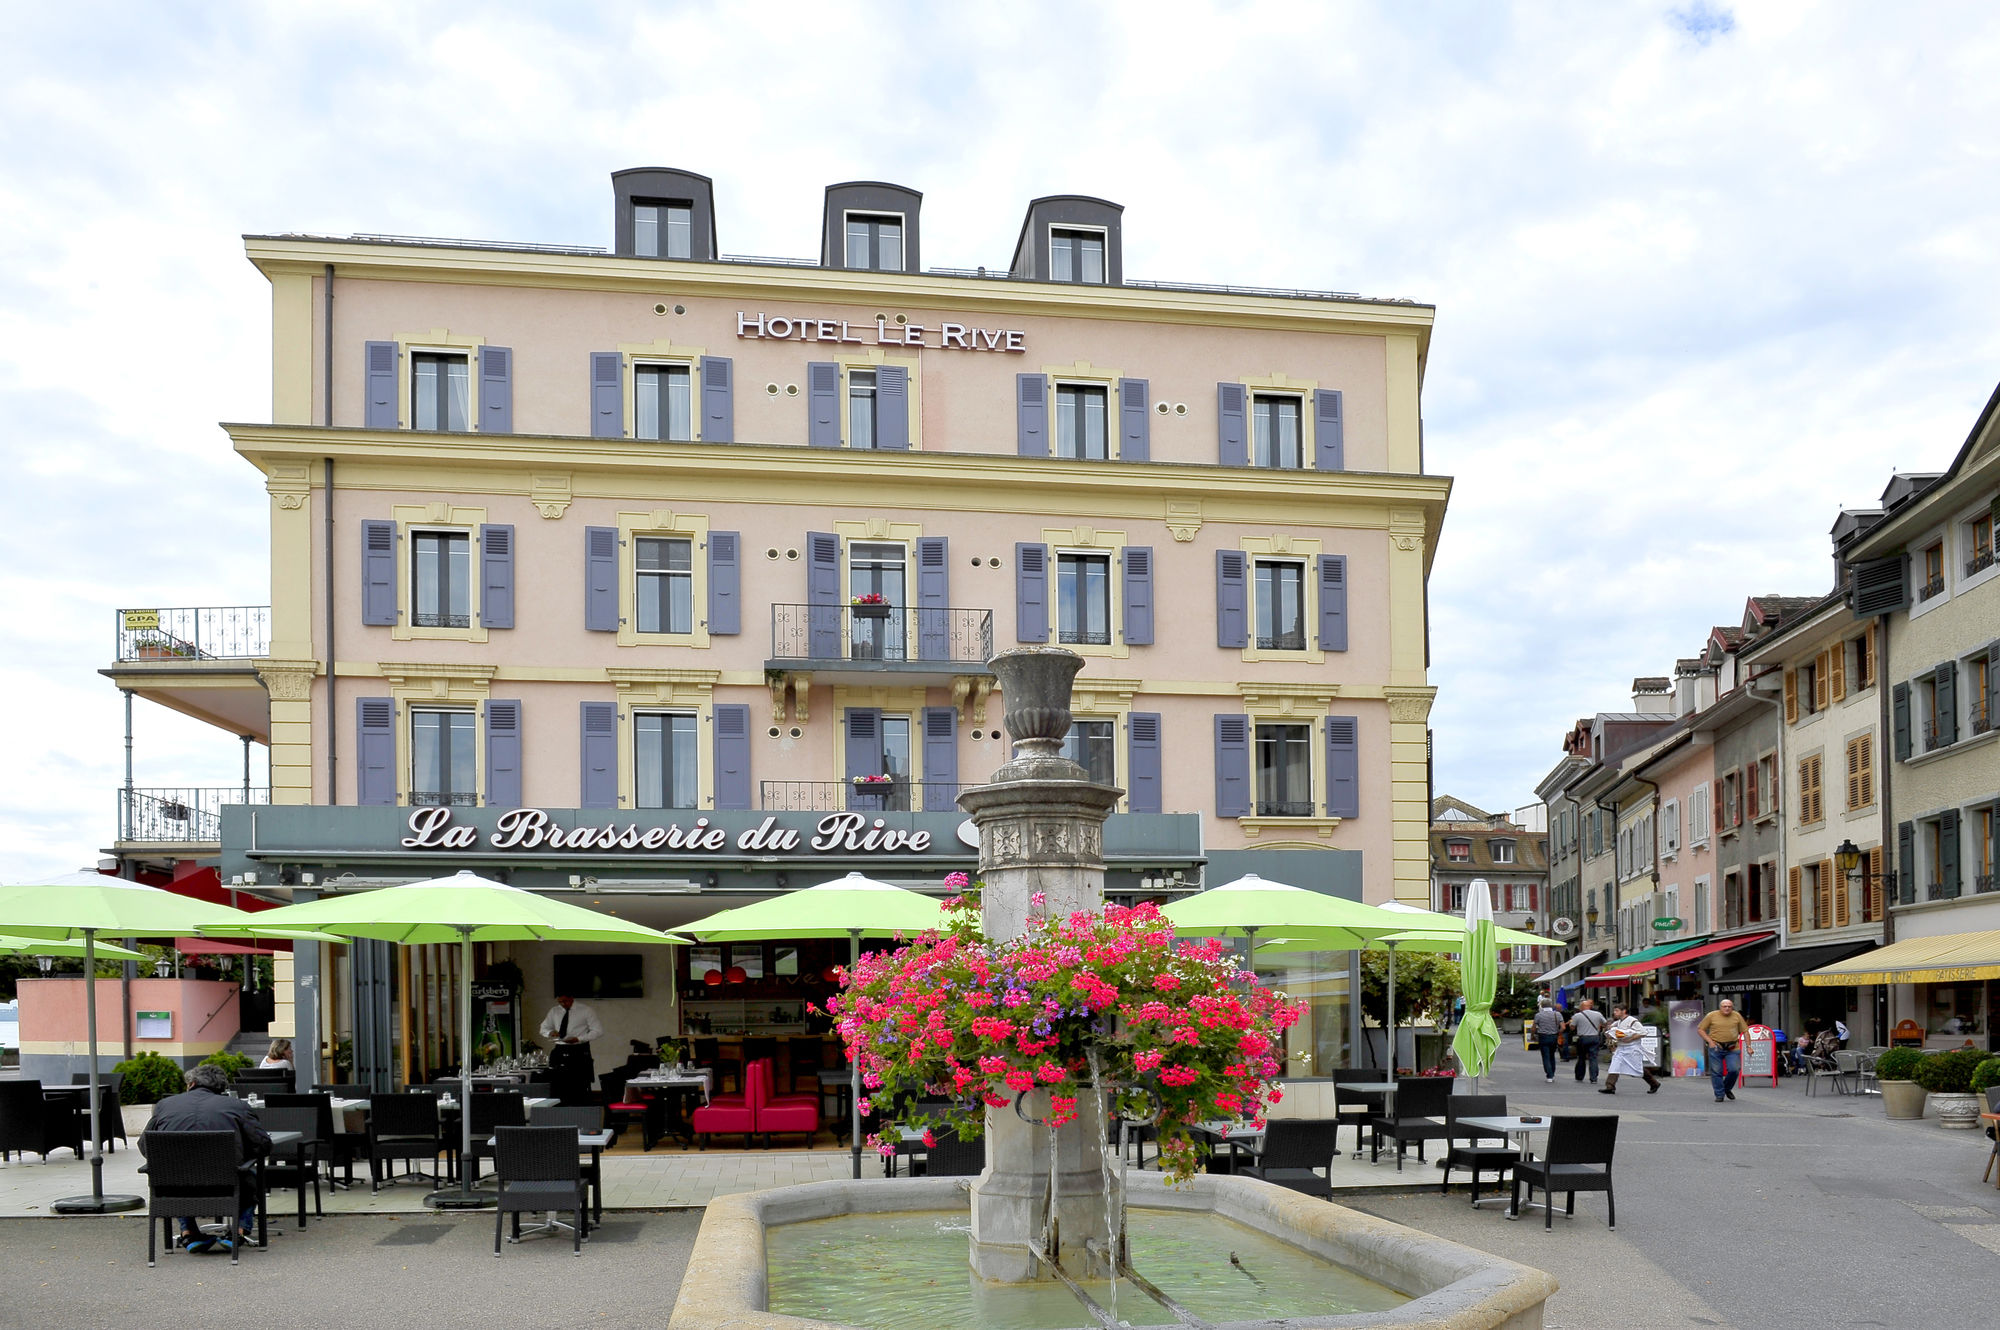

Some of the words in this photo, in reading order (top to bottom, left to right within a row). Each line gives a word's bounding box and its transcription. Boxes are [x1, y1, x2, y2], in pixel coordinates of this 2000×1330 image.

[737, 311, 862, 343] HOTEL
[877, 319, 925, 346] LE
[941, 322, 1026, 351] RIVE
[401, 807, 477, 849] La
[490, 808, 726, 850] Brasserie
[737, 816, 800, 851] du
[810, 812, 931, 852] Rive
